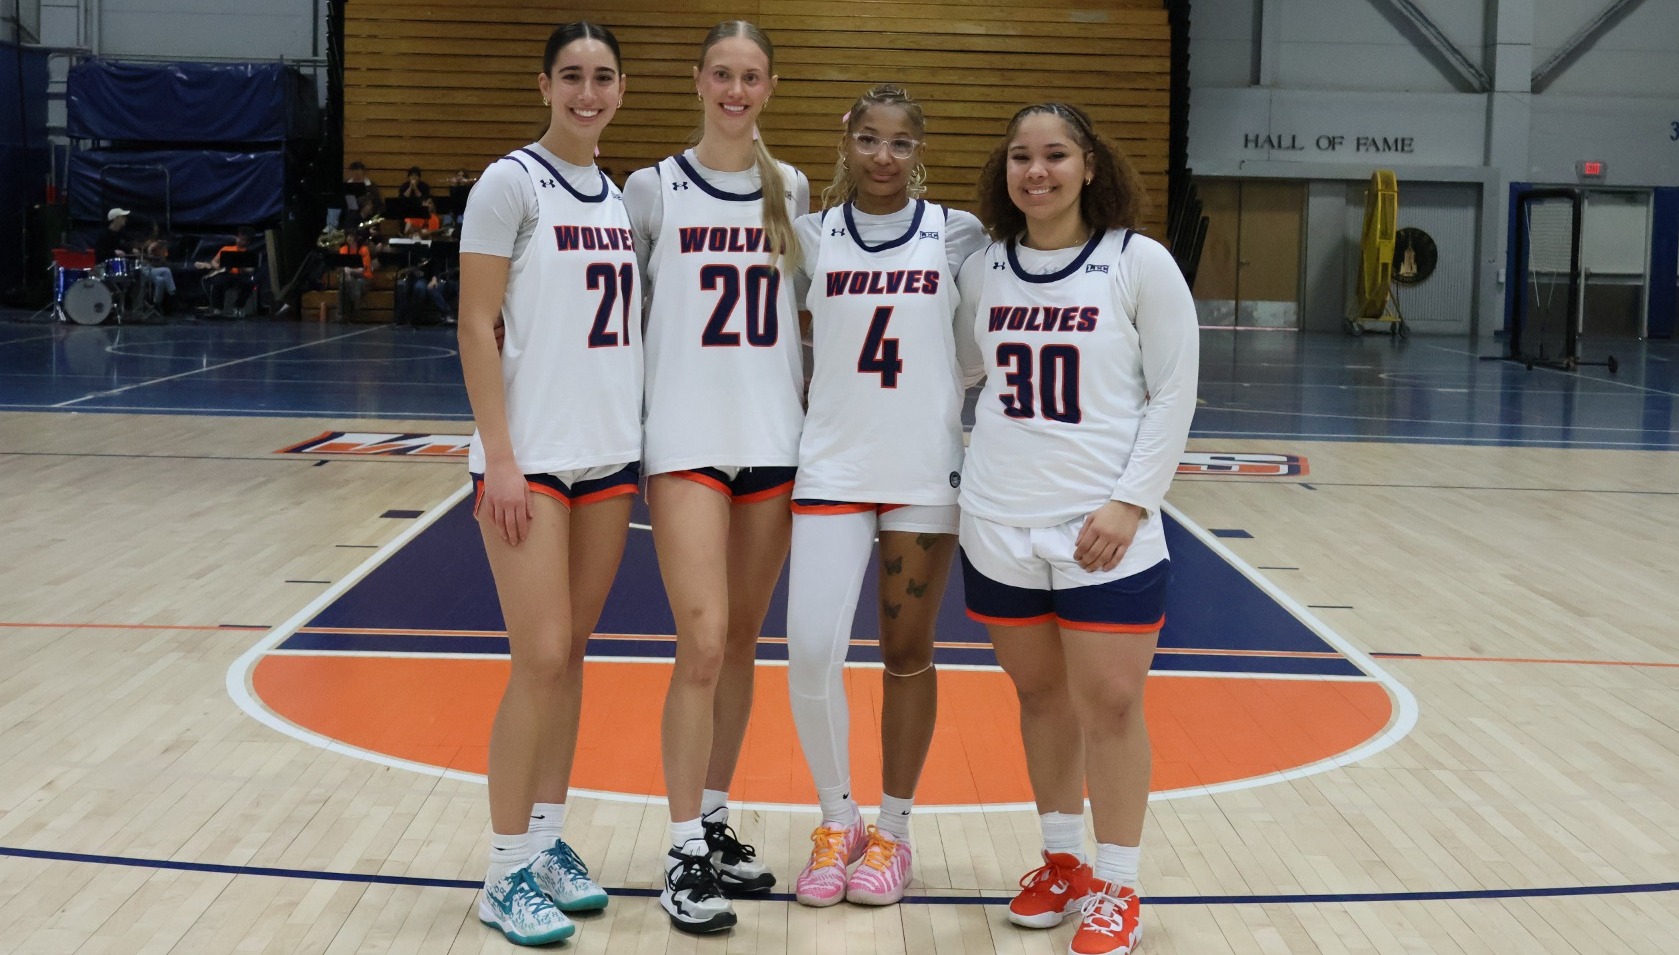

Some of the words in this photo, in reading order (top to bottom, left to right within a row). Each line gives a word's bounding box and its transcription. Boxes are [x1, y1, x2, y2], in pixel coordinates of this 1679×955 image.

[1243, 133, 1304, 150] HALL
[1315, 134, 1345, 151] OF
[1356, 136, 1414, 153] FAME
[679, 226, 785, 255] WOLV
[586, 262, 634, 348] 21
[699, 263, 780, 347] 20
[826, 270, 940, 297] WOLVES
[988, 306, 1100, 332] WOLVES
[857, 305, 903, 389] 4
[996, 342, 1082, 424] 30
